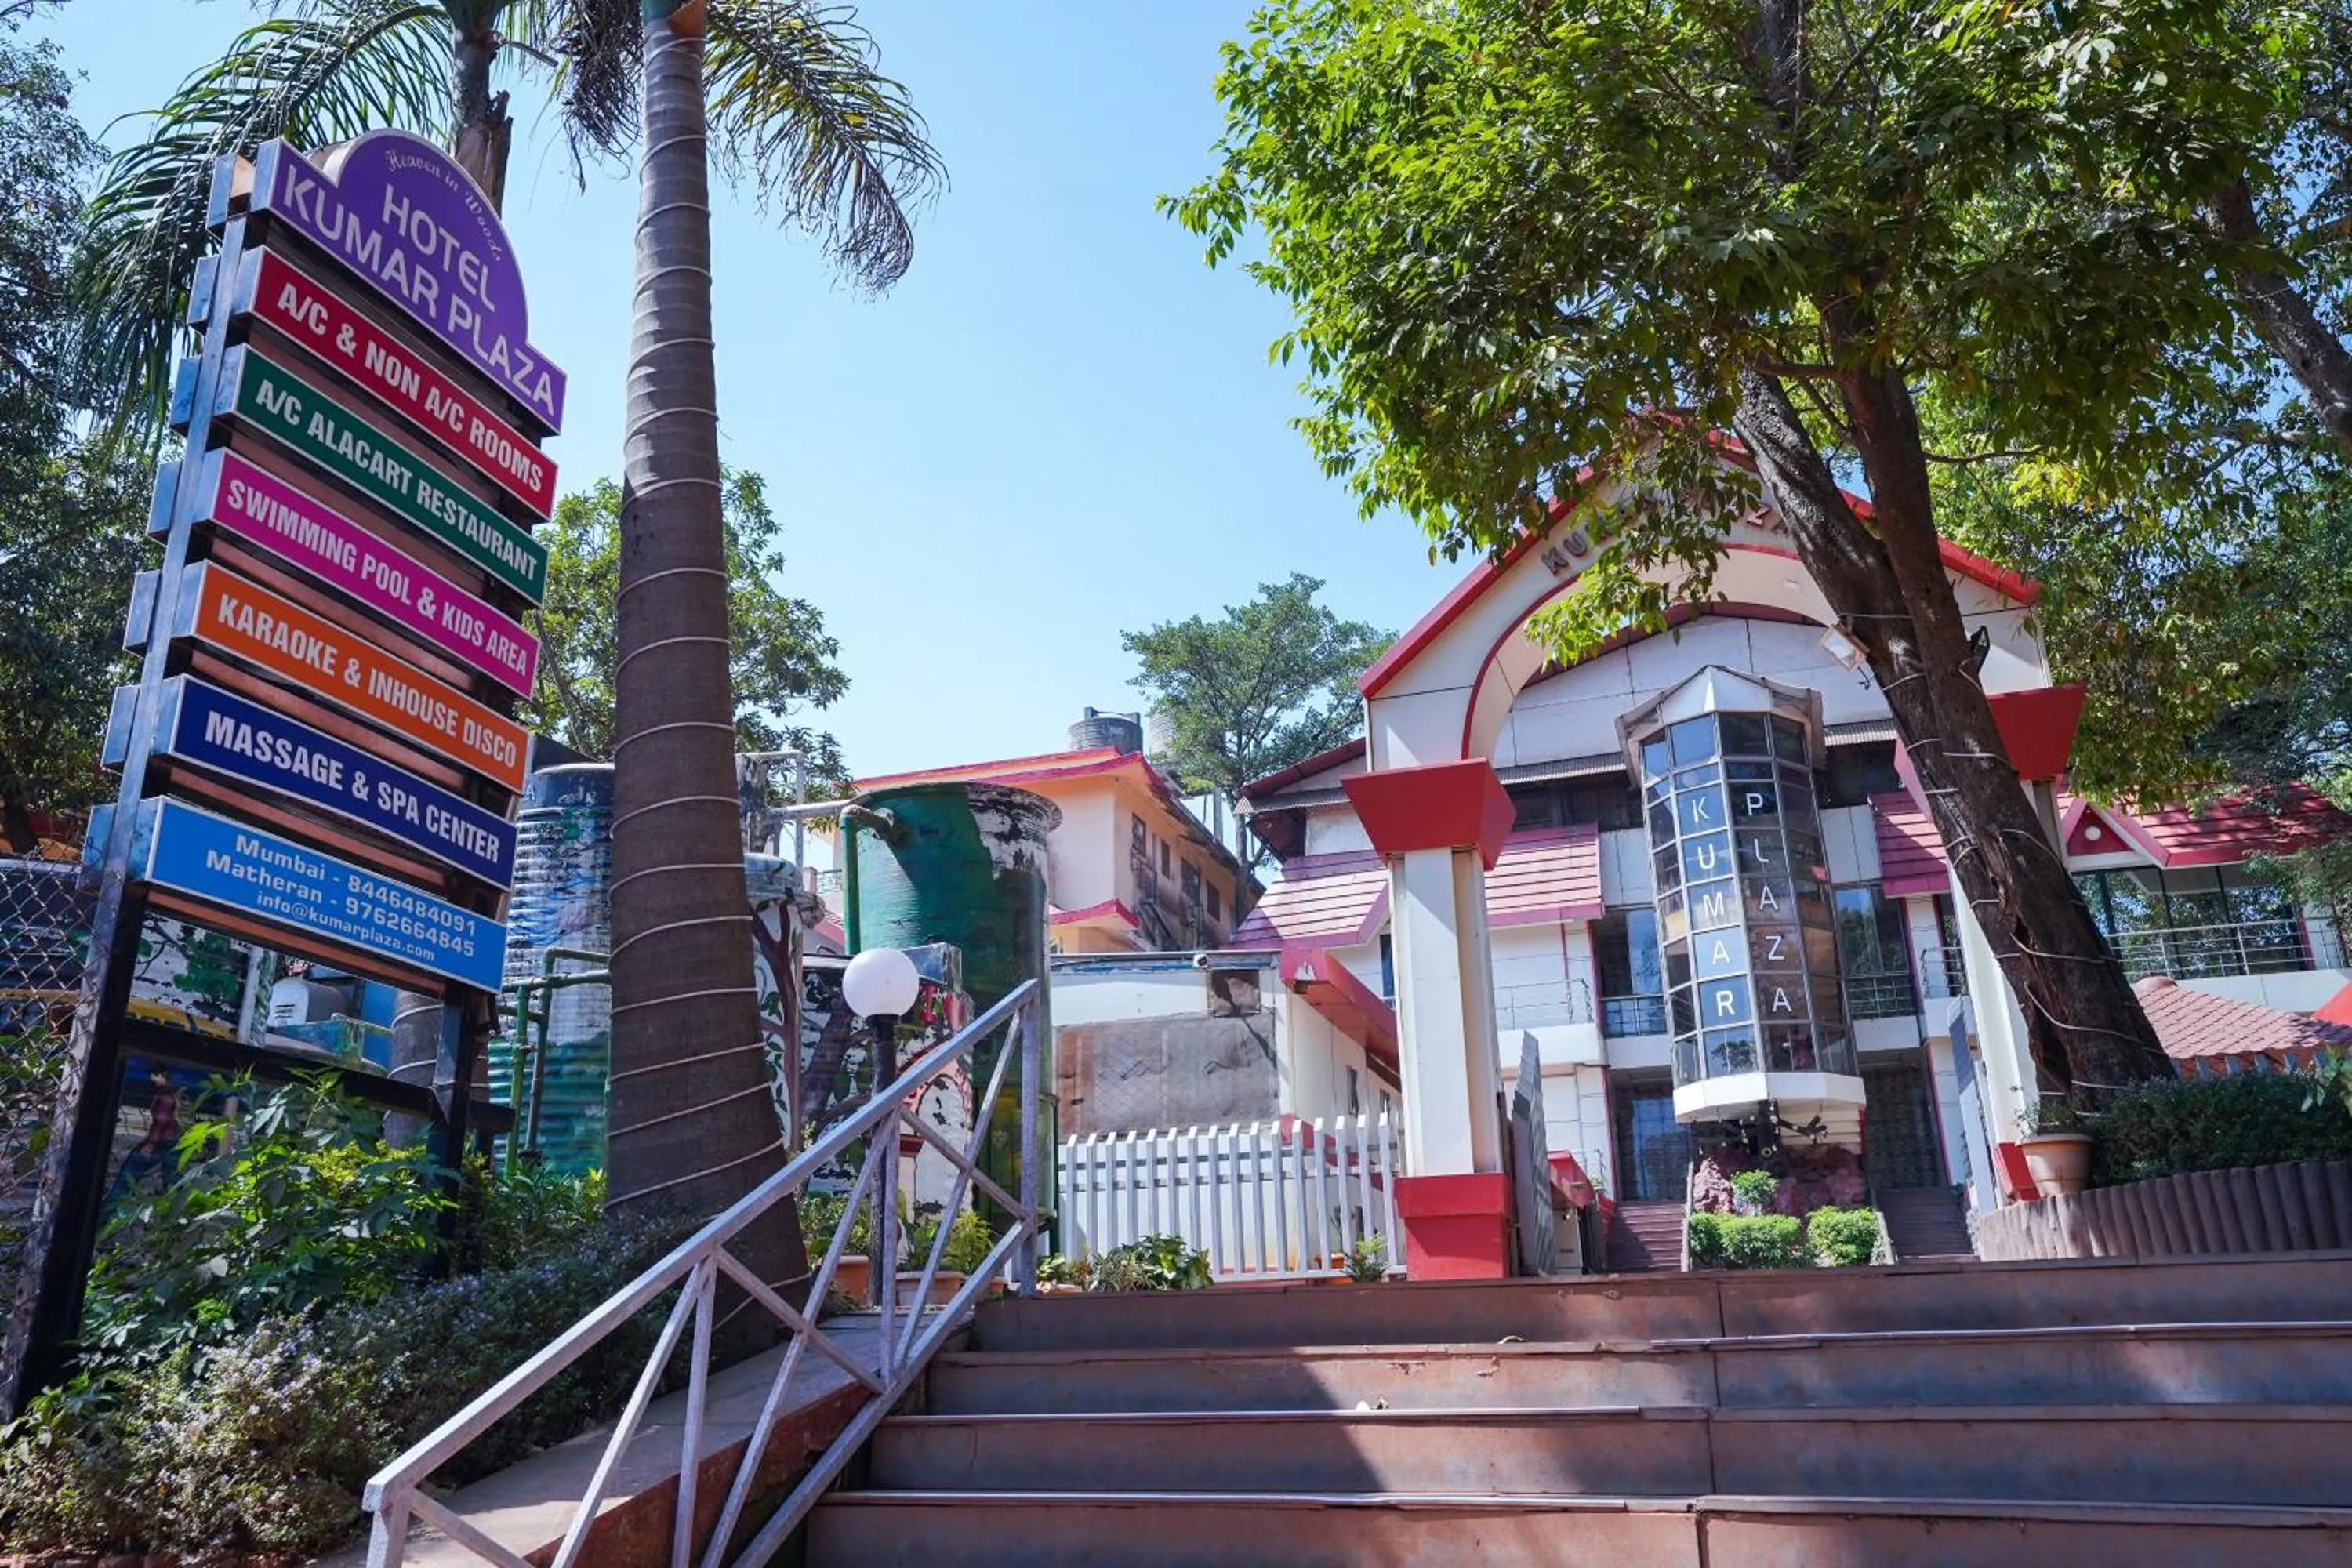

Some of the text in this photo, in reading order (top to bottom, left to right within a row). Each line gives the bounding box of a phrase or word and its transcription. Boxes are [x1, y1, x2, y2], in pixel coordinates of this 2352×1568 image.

[382, 184, 495, 312] HOTEL
[385, 149, 441, 178] Heaven
[445, 171, 459, 192] in
[283, 165, 555, 416] KUMAR PLAZA
[277, 283, 544, 493] A/C & NON A/C ROOMS
[256, 379, 538, 582] A/C ALACART RESTAURANT
[227, 479, 528, 678] SWIMMING POOL & KIDS AREA
[218, 593, 516, 769] KARAOKE & INHOUSE DISCO
[205, 710, 501, 864] MASSAGE & SPA CENTER
[206, 850, 323, 904] Matheran
[346, 897, 474, 957] 9762664845
[236, 834, 326, 881] Mumbai
[347, 874, 476, 936] 8446484091
[257, 890, 435, 961] info@kumarplaza.com
[1692, 794, 1734, 1017] KUMAR
[1746, 793, 1793, 1013] PLAZA
